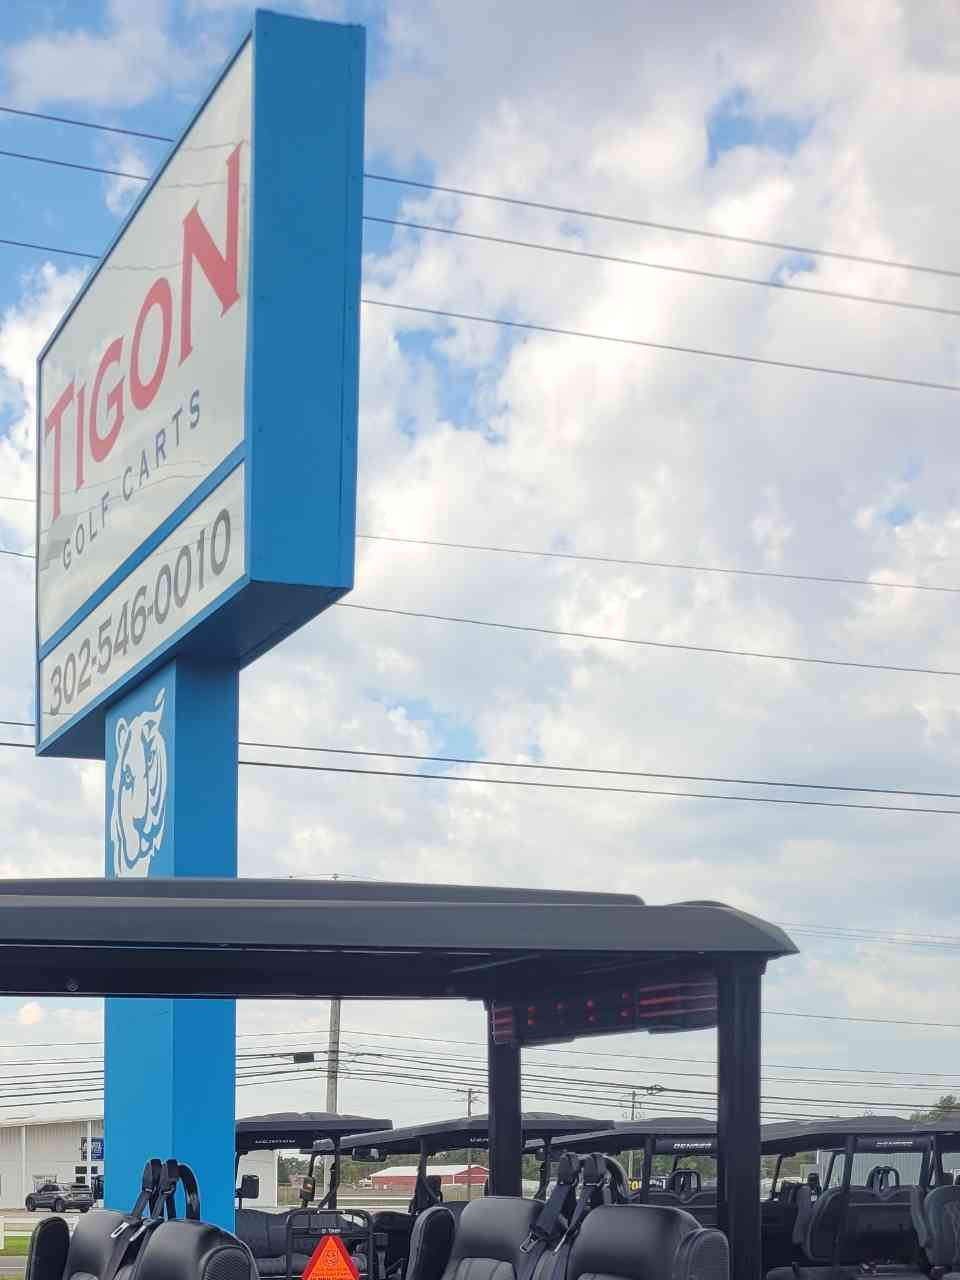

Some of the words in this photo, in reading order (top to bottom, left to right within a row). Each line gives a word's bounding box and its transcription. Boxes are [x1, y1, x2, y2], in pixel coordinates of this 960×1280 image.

[44, 140, 241, 522] TIGON
[63, 491, 110, 570] GOLF
[122, 389, 201, 502] CARTS
[49, 508, 232, 716] 302-546-0010
